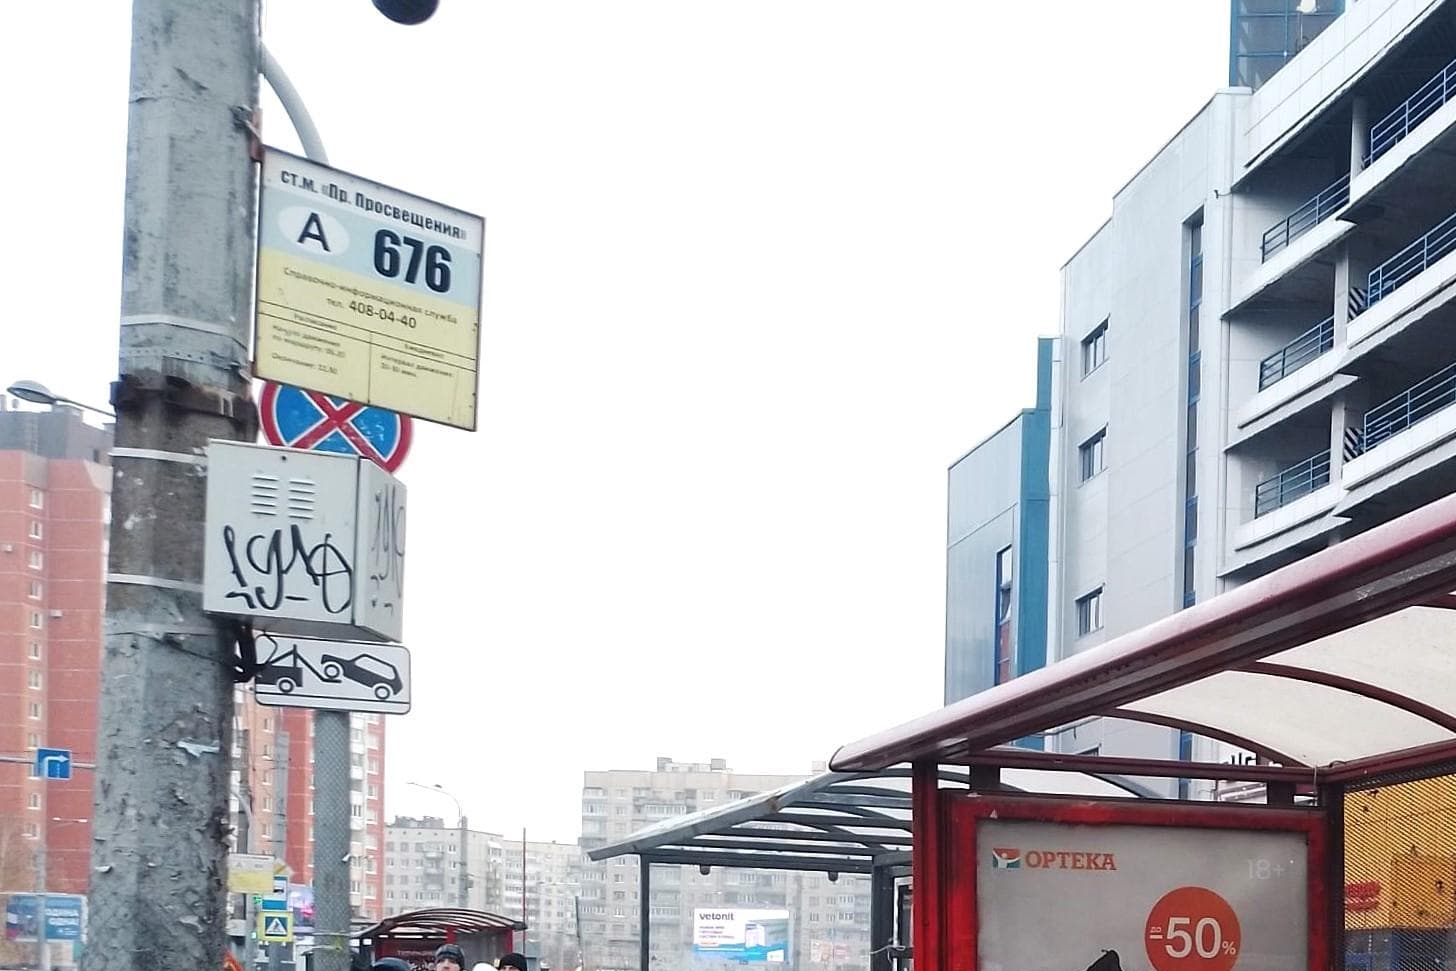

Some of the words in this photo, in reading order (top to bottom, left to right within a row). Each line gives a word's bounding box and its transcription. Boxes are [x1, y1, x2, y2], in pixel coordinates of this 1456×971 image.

[297, 212, 331, 252] А
[374, 229, 451, 293] 676
[348, 300, 417, 329] 408-04-40
[1026, 851, 1117, 871] ОРТЕКА
[1249, 859, 1284, 880] 18+
[699, 912, 734, 921] vetonit
